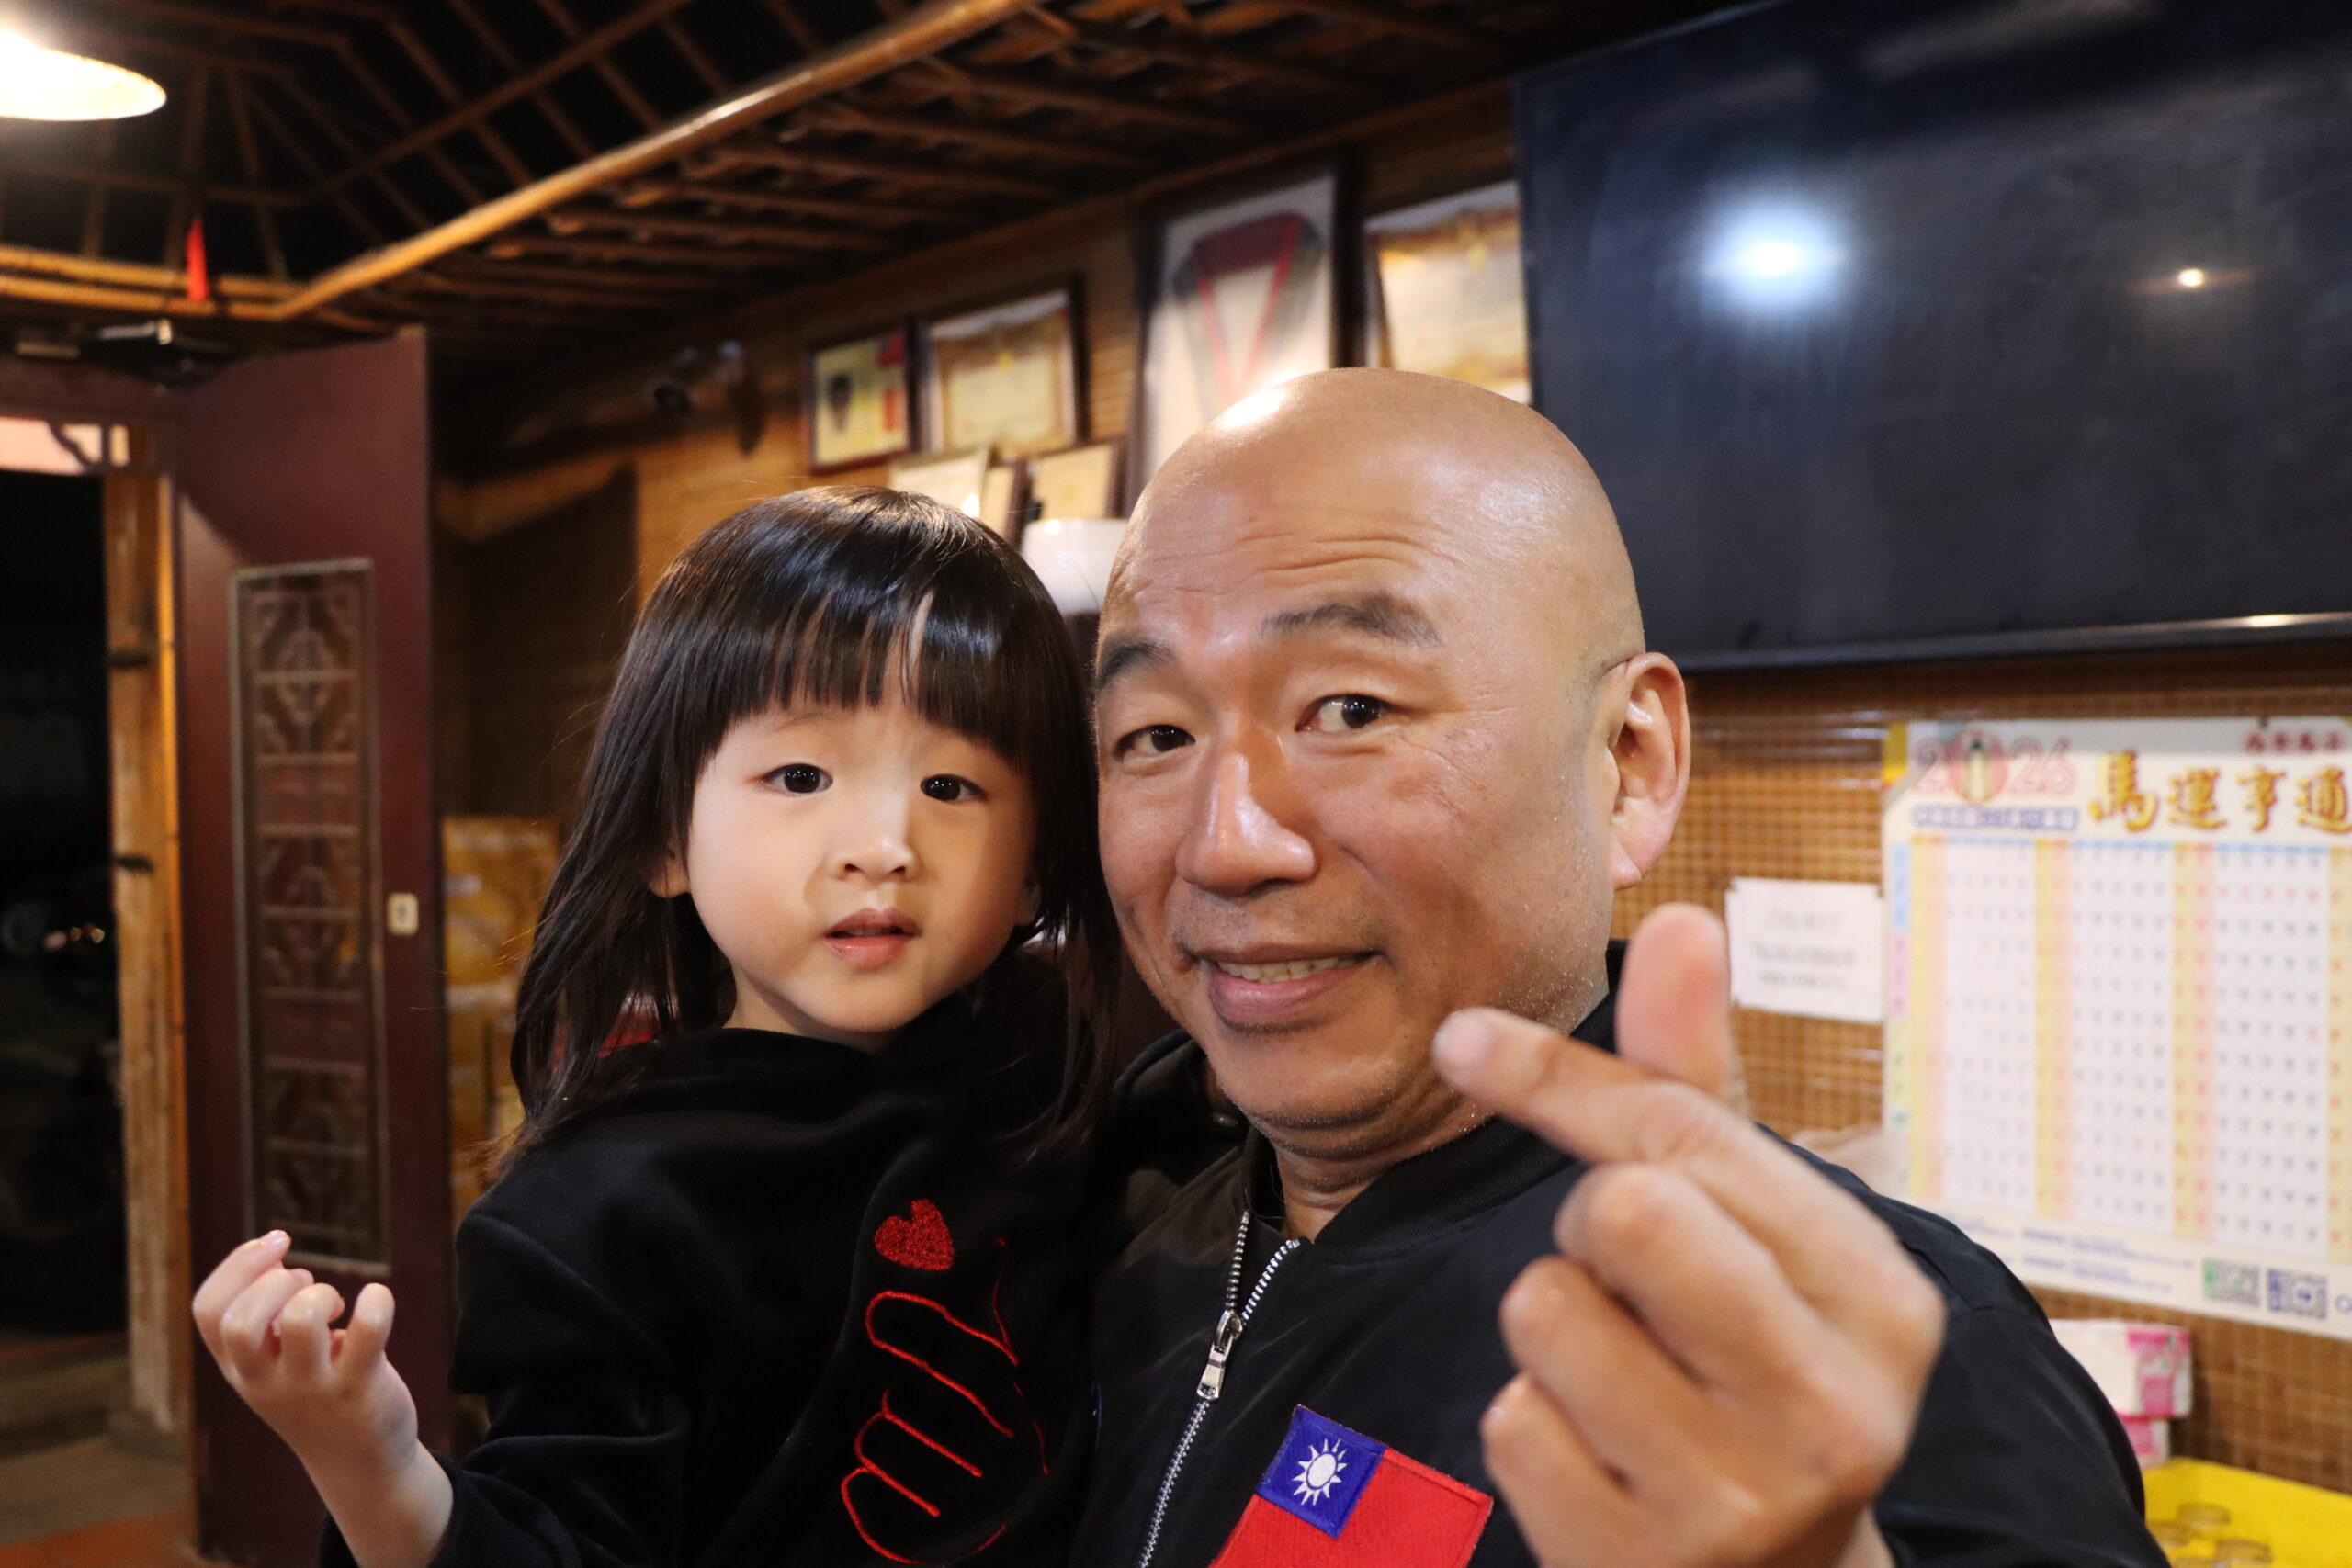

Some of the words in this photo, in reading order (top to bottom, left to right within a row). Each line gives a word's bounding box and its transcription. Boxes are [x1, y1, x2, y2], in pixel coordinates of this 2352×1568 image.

[1911, 729, 2078, 804] 2026
[2087, 749, 2352, 833] 馬運亨通
